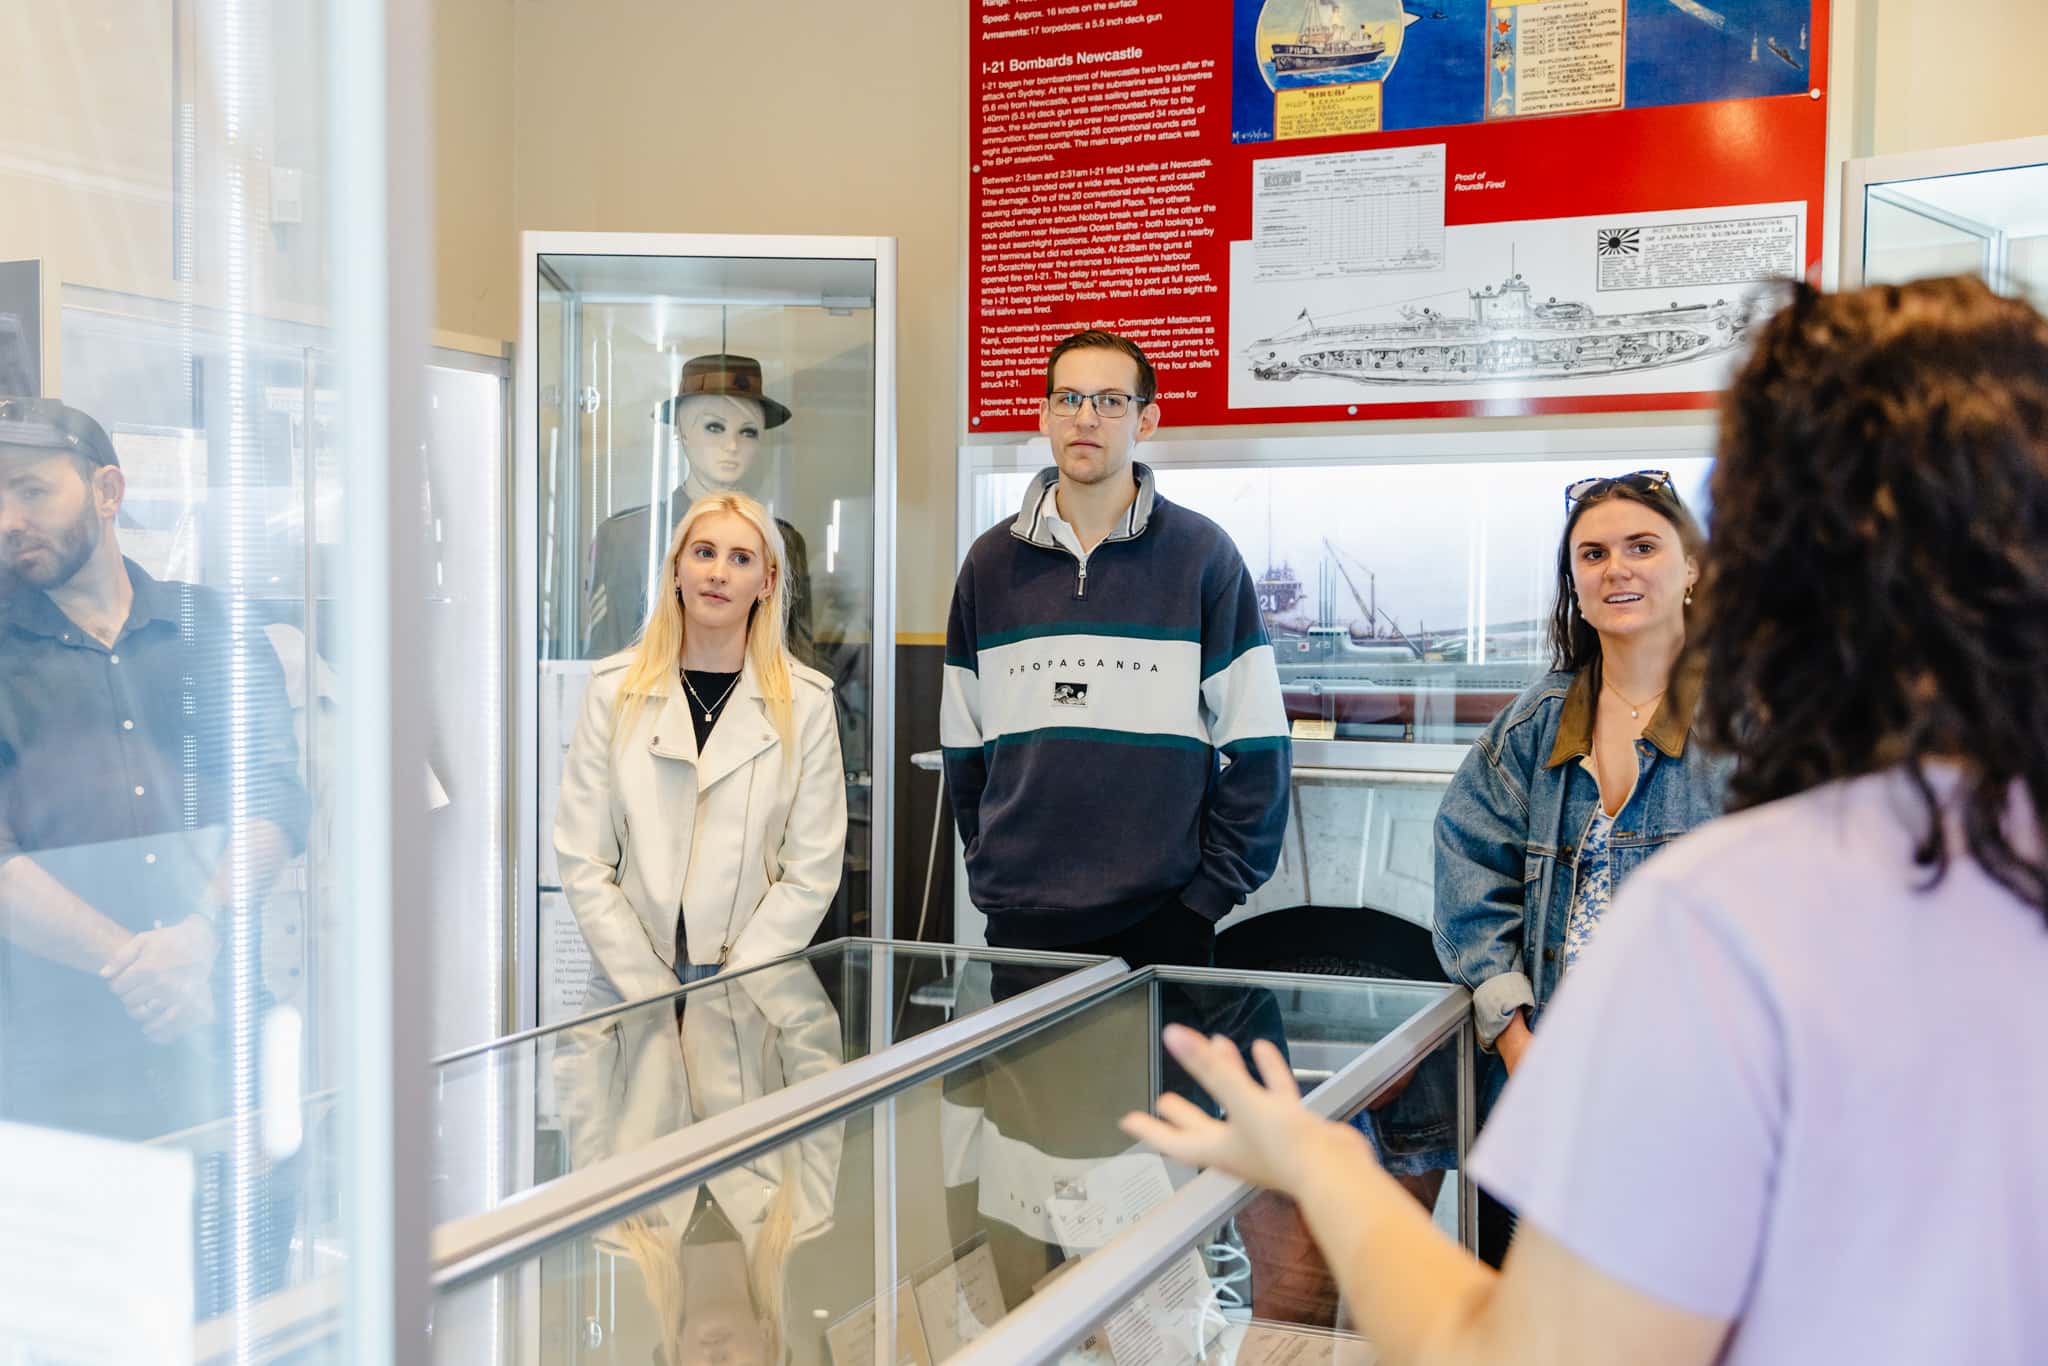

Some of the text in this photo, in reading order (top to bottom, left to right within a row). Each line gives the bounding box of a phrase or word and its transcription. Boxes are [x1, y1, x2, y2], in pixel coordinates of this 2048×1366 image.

[982, 13, 1010, 24] Speed:
[1057, 5, 1080, 14] knots
[1093, 2, 1106, 10] the
[1108, 0, 1137, 9] surface
[1092, 18, 1104, 28] 5.5
[1106, 17, 1123, 26] inch
[1124, 14, 1144, 24] deck
[1146, 13, 1162, 23] gun
[982, 46, 1142, 74] I-21 Bombards Newcastle
[982, 81, 996, 90] I-21
[998, 80, 1021, 89] began
[1036, 72, 1089, 84] bombardment
[1100, 67, 1140, 77] Newcastle
[1157, 63, 1180, 72] hours
[1181, 61, 1200, 69] after
[982, 92, 1004, 101] attack
[1017, 89, 1045, 98] Sydney.
[1106, 78, 1146, 88] submarine
[1172, 71, 1212, 81] kilometres
[1036, 109, 1055, 118] deck
[1056, 108, 1071, 117] gun
[1150, 98, 1168, 106] Prior
[1180, 96, 1193, 104] the
[1067, 118, 1082, 127] gun
[1103, 113, 1118, 122] had
[1119, 110, 1154, 122] prepared
[1167, 106, 1195, 116] rounds
[982, 176, 1013, 184] Between
[1015, 173, 1042, 182] 2:15am
[1044, 171, 1058, 179] and
[1060, 169, 1088, 178] 2:31am
[1089, 167, 1104, 175] I-21
[1106, 165, 1123, 174] fired
[1136, 162, 1158, 171] shells
[1169, 158, 1212, 168] Newcastle.
[1454, 172, 1486, 182] Proof of
[1005, 185, 1030, 193] rounds
[1032, 182, 1057, 191] landed
[1083, 179, 1102, 187] wide
[1159, 172, 1175, 181] and
[1176, 170, 1205, 180] caused
[1454, 180, 1506, 192] Rounds Fired
[982, 209, 1010, 217] causing
[1011, 207, 1041, 215] damage
[1122, 198, 1145, 206] Place.
[1148, 196, 1164, 204] Two
[1165, 195, 1190, 203] others
[981, 264, 996, 272] Fort
[1069, 258, 1102, 266] entrance
[1113, 254, 1159, 264] Newcastle's
[1160, 252, 1190, 260] harbour
[981, 274, 1009, 284] opened
[1053, 270, 1068, 278] The
[1068, 270, 1089, 278] delay
[1099, 267, 1133, 276] returning
[1134, 265, 1147, 274] fire
[1148, 263, 1180, 272] resulted
[1041, 321, 1090, 330] commanding
[1117, 317, 1165, 326] Commander
[1166, 315, 1211, 323] Matsumura
[1002, 334, 1039, 344] continued
[1040, 334, 1052, 342] the
[1119, 329, 1149, 338] another
[995, 370, 1014, 378] guns
[1015, 368, 1030, 376] had
[1030, 367, 1046, 375] fired
[1188, 360, 1211, 368] shells
[980, 380, 1003, 388] struck
[1186, 390, 1197, 398] for
[1009, 658, 1159, 676] PROPAGANDA
